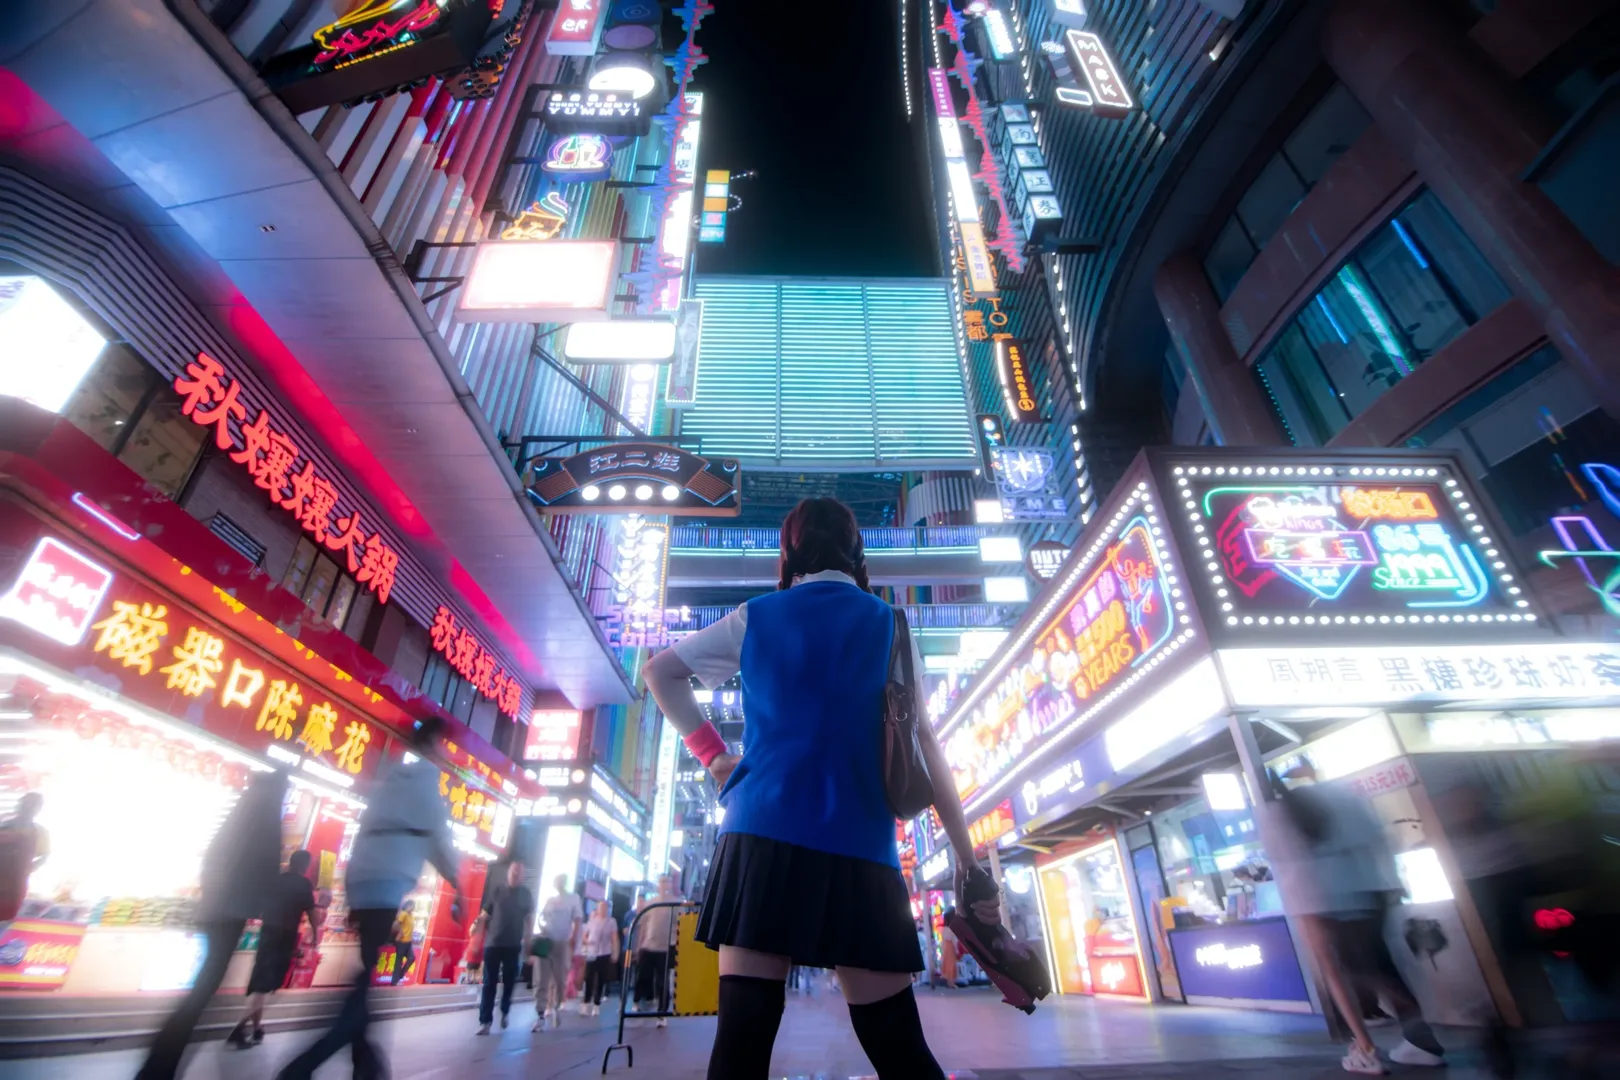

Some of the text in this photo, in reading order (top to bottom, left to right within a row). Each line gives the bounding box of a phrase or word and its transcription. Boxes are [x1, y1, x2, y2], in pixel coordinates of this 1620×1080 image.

[92, 600, 371, 774] 磁器口陈麻花
[1083, 633, 1134, 691] YEARS
[1378, 652, 1620, 692] 黑糖珍珠奶茶
